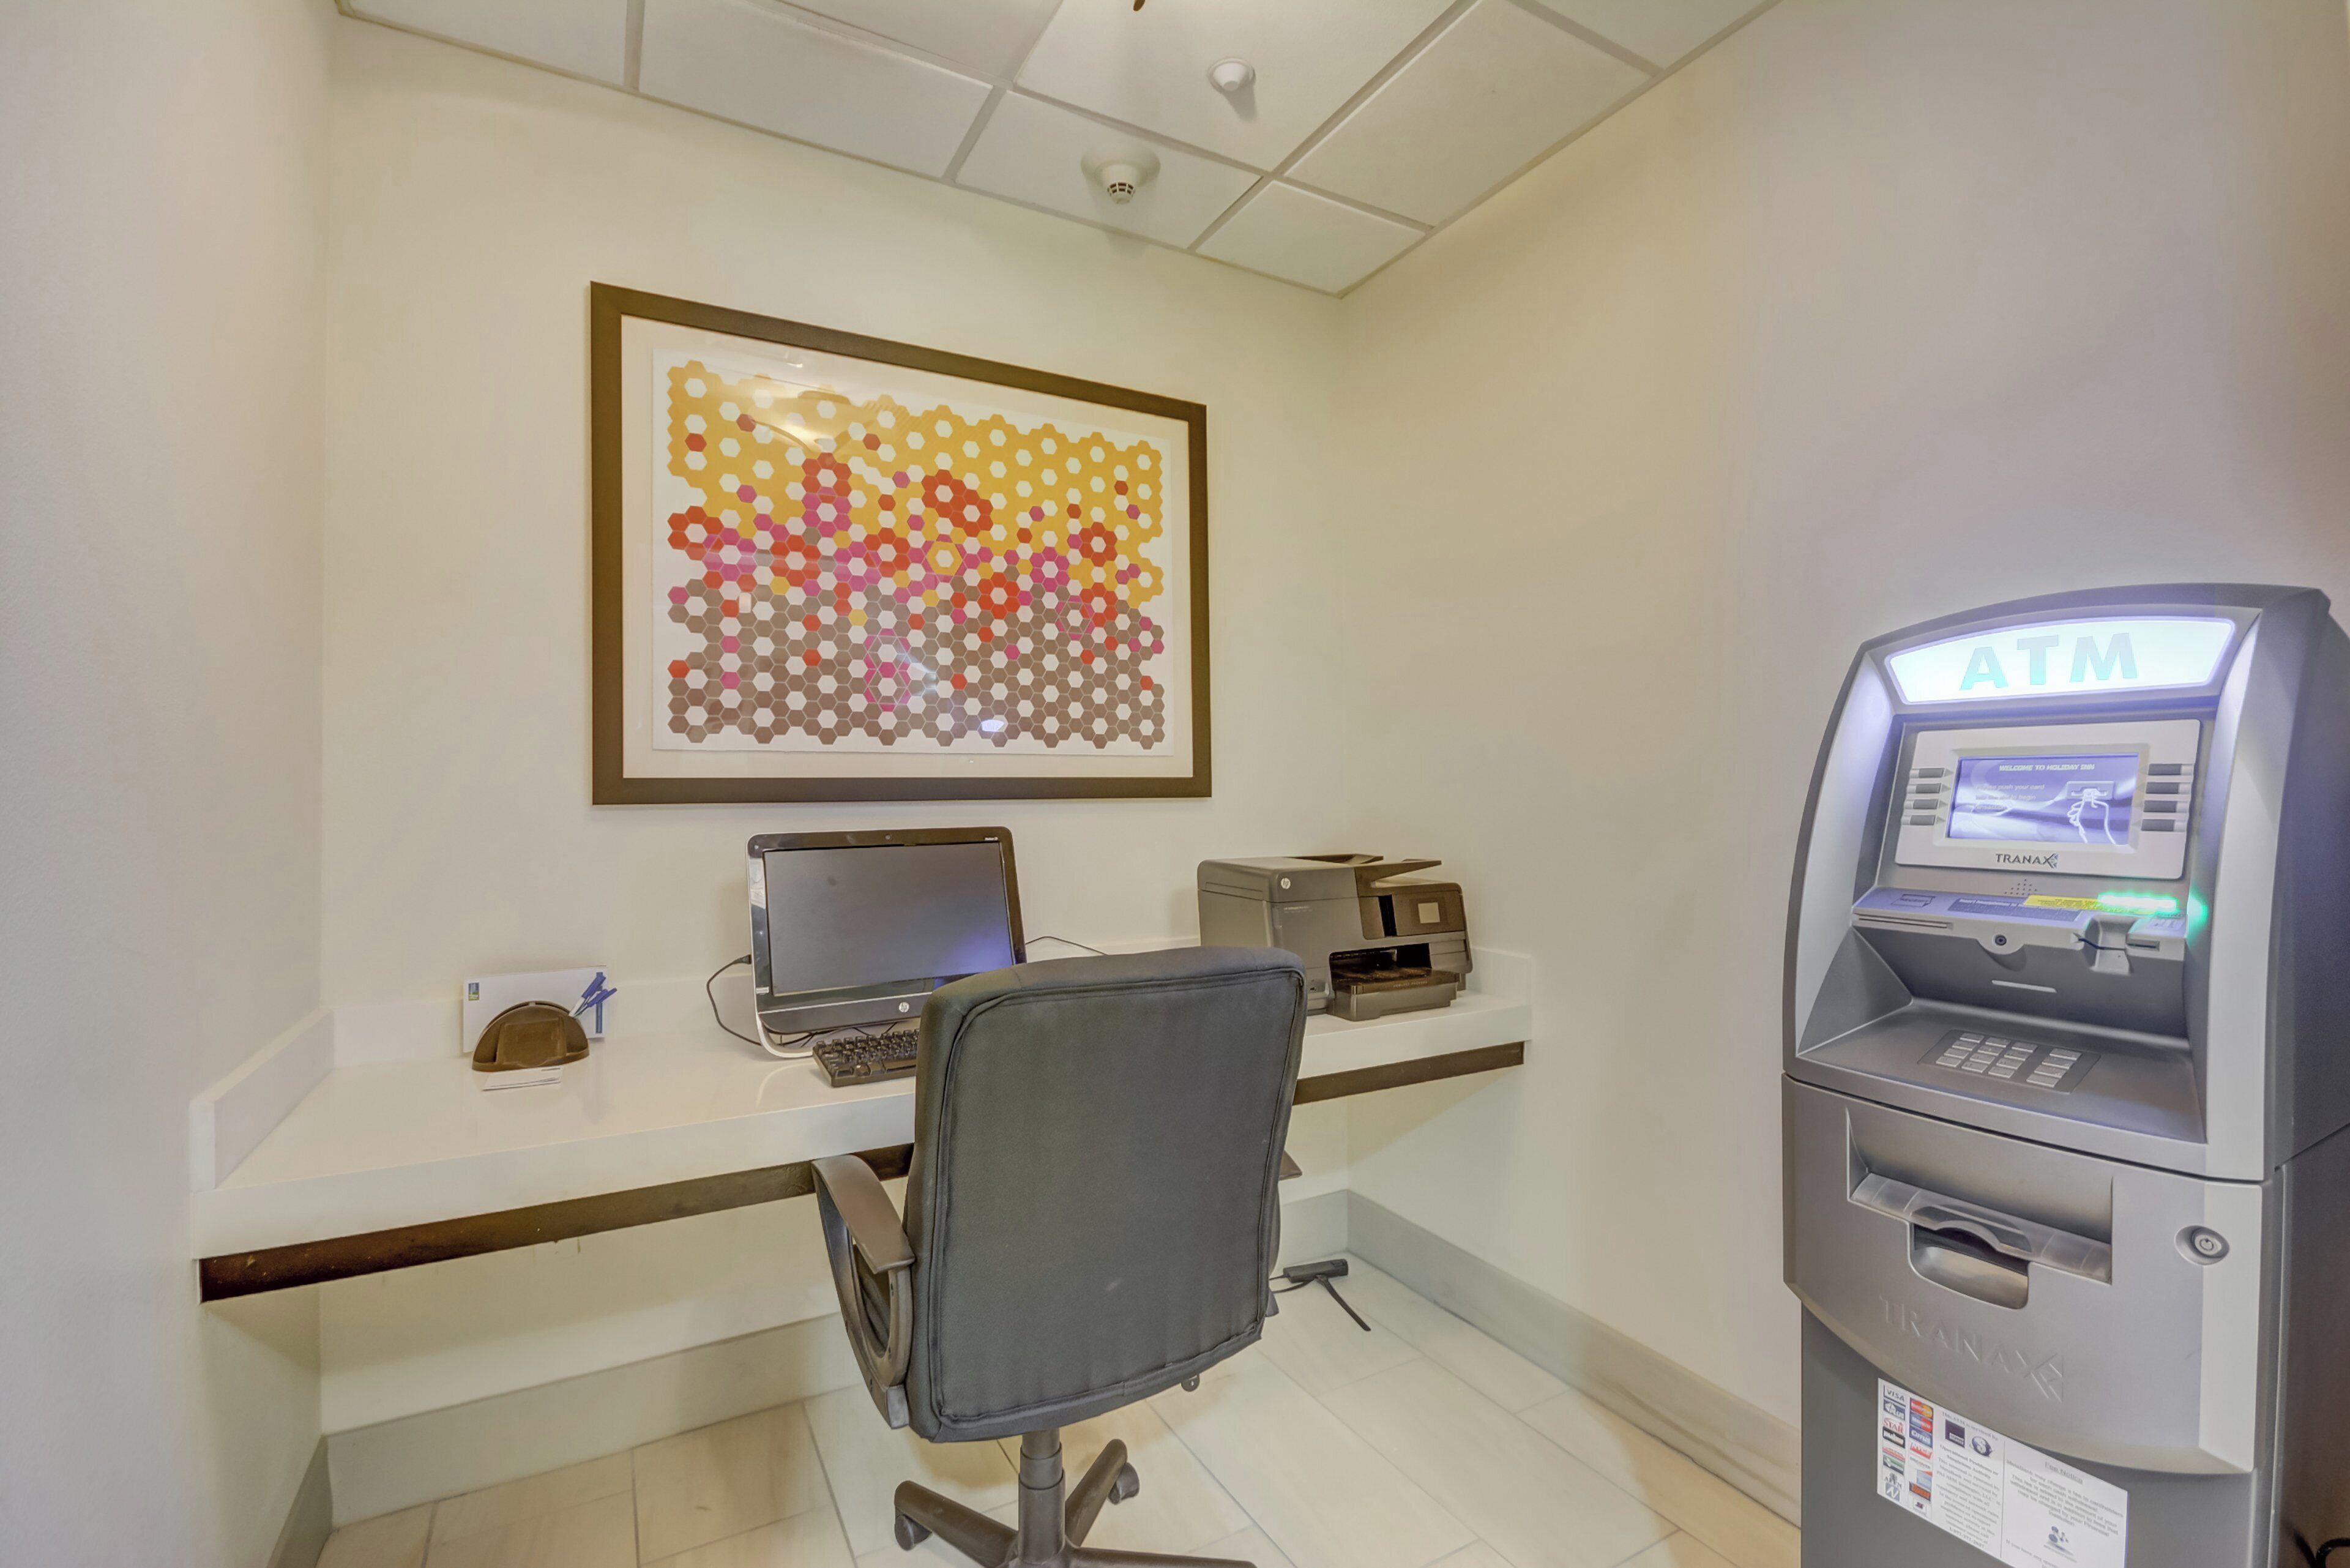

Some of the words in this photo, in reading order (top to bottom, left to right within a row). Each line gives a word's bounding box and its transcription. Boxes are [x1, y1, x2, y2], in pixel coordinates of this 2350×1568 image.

[1959, 632, 2138, 690] ATM
[1996, 853, 2058, 869] TRANAX
[1879, 1294, 2060, 1401] TRANAX
[1886, 1387, 1904, 1402] VISA
[1884, 1419, 1903, 1433] STAR
